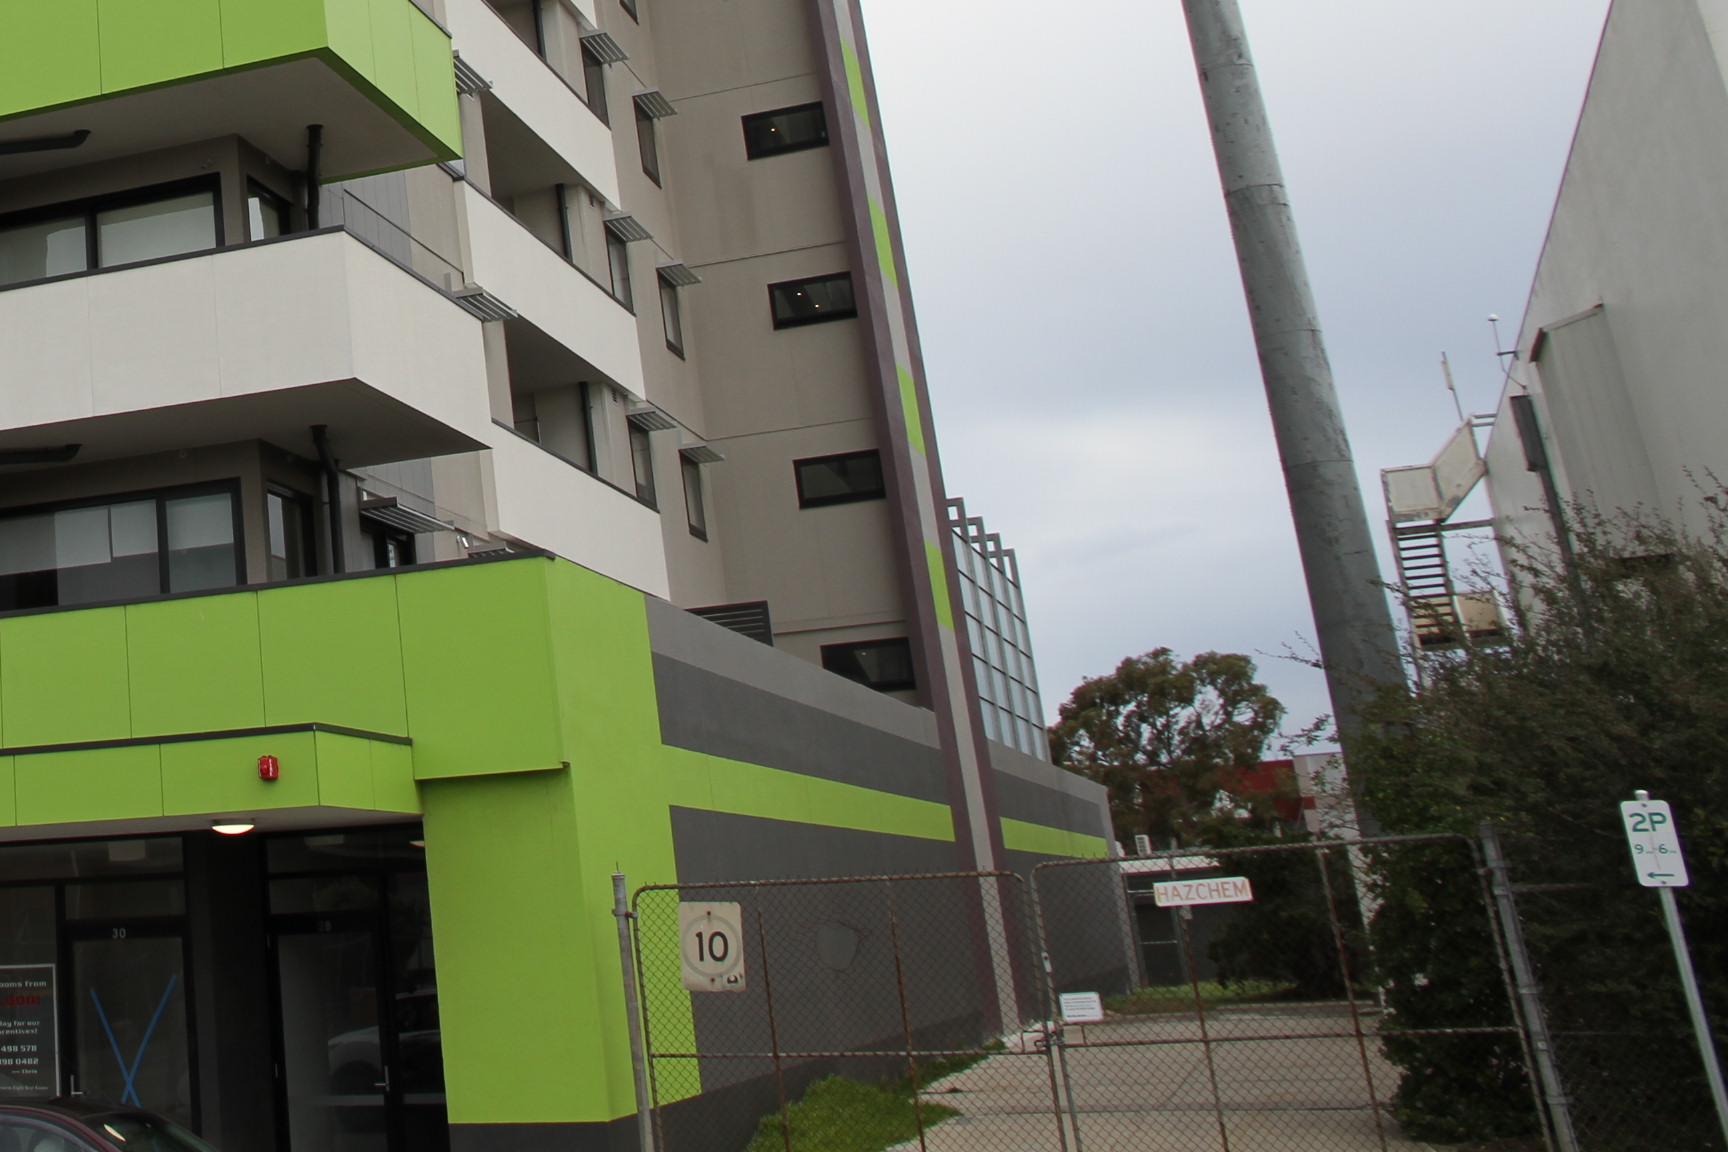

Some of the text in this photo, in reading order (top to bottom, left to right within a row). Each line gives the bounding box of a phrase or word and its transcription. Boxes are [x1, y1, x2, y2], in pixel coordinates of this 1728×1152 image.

[1629, 812, 1667, 832] 2P
[1634, 844, 1644, 854] 9
[1156, 880, 1249, 903] HAZCHEM
[112, 928, 126, 938] 30
[695, 931, 729, 962] 10
